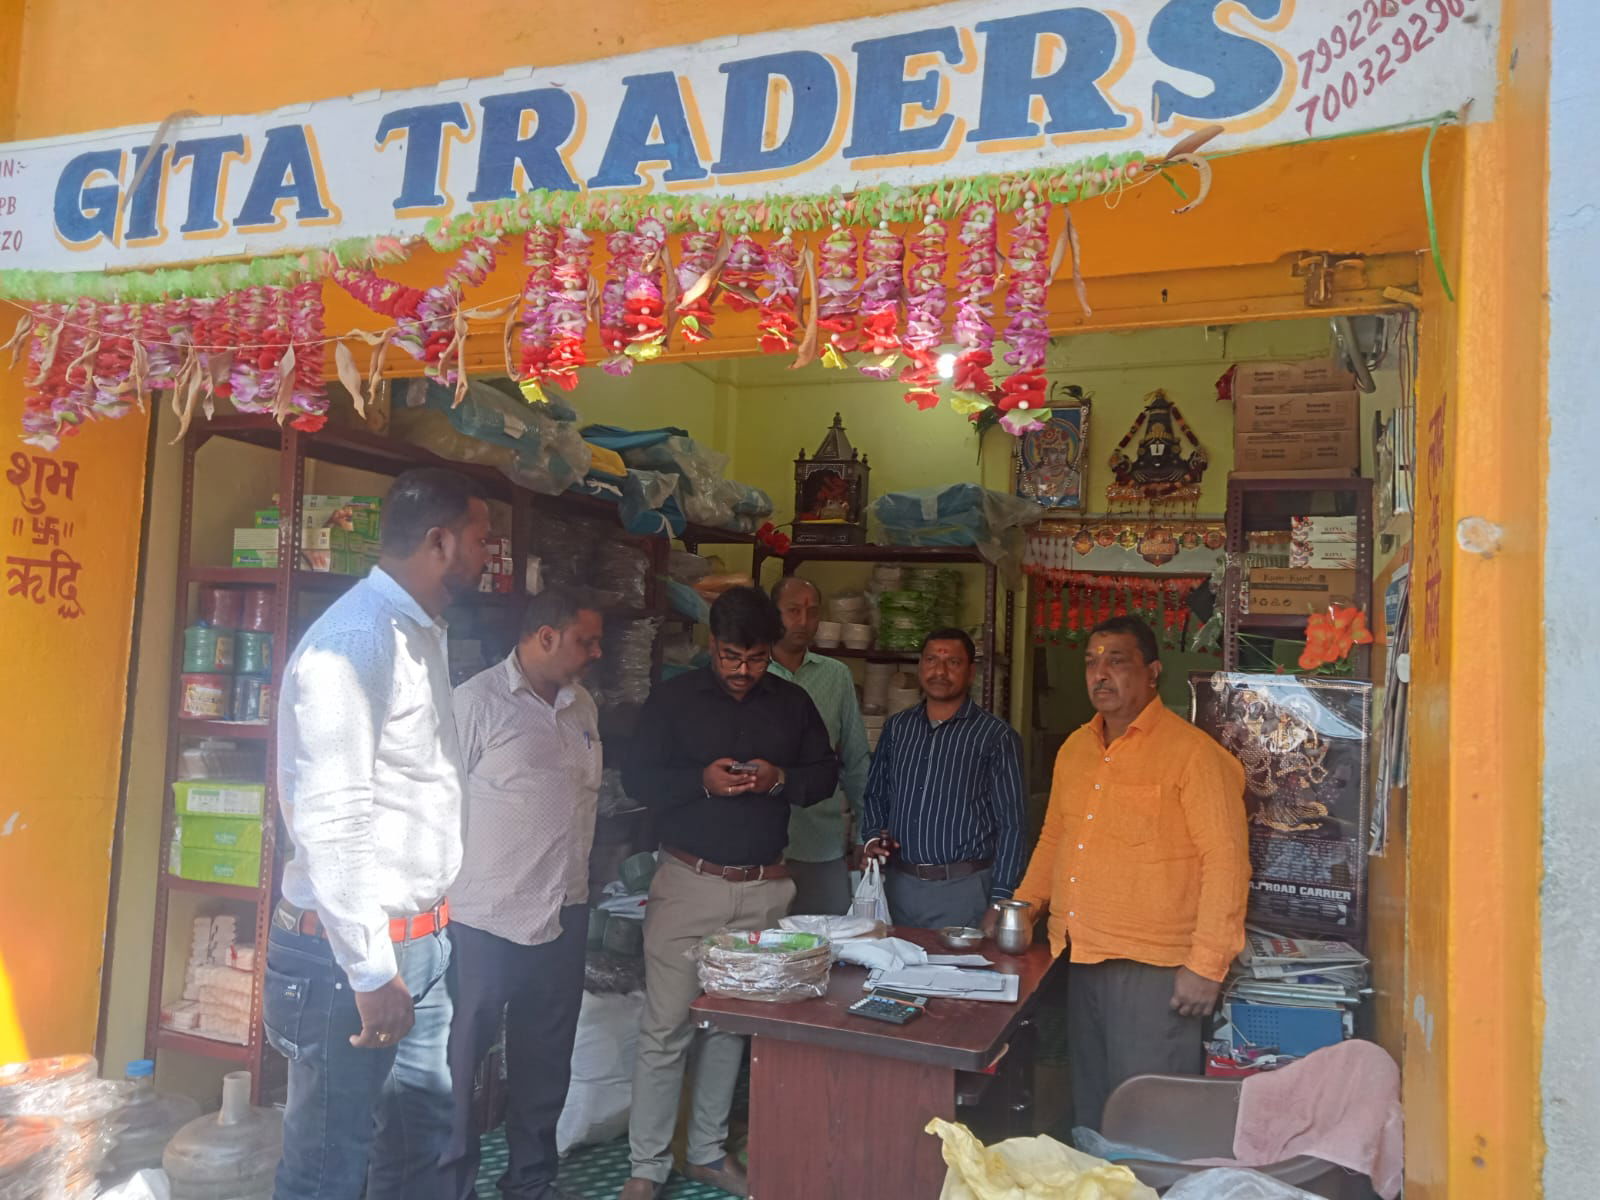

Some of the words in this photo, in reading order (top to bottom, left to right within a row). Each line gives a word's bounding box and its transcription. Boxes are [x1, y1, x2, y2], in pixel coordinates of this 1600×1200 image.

[1298, 0, 1414, 89] 79922
[54, 123, 341, 252] GITA
[374, 0, 1297, 217] TRADERS
[6, 452, 79, 514] शुभ
[1264, 882, 1297, 894] ROAD
[1299, 885, 1351, 900] CARRIER
